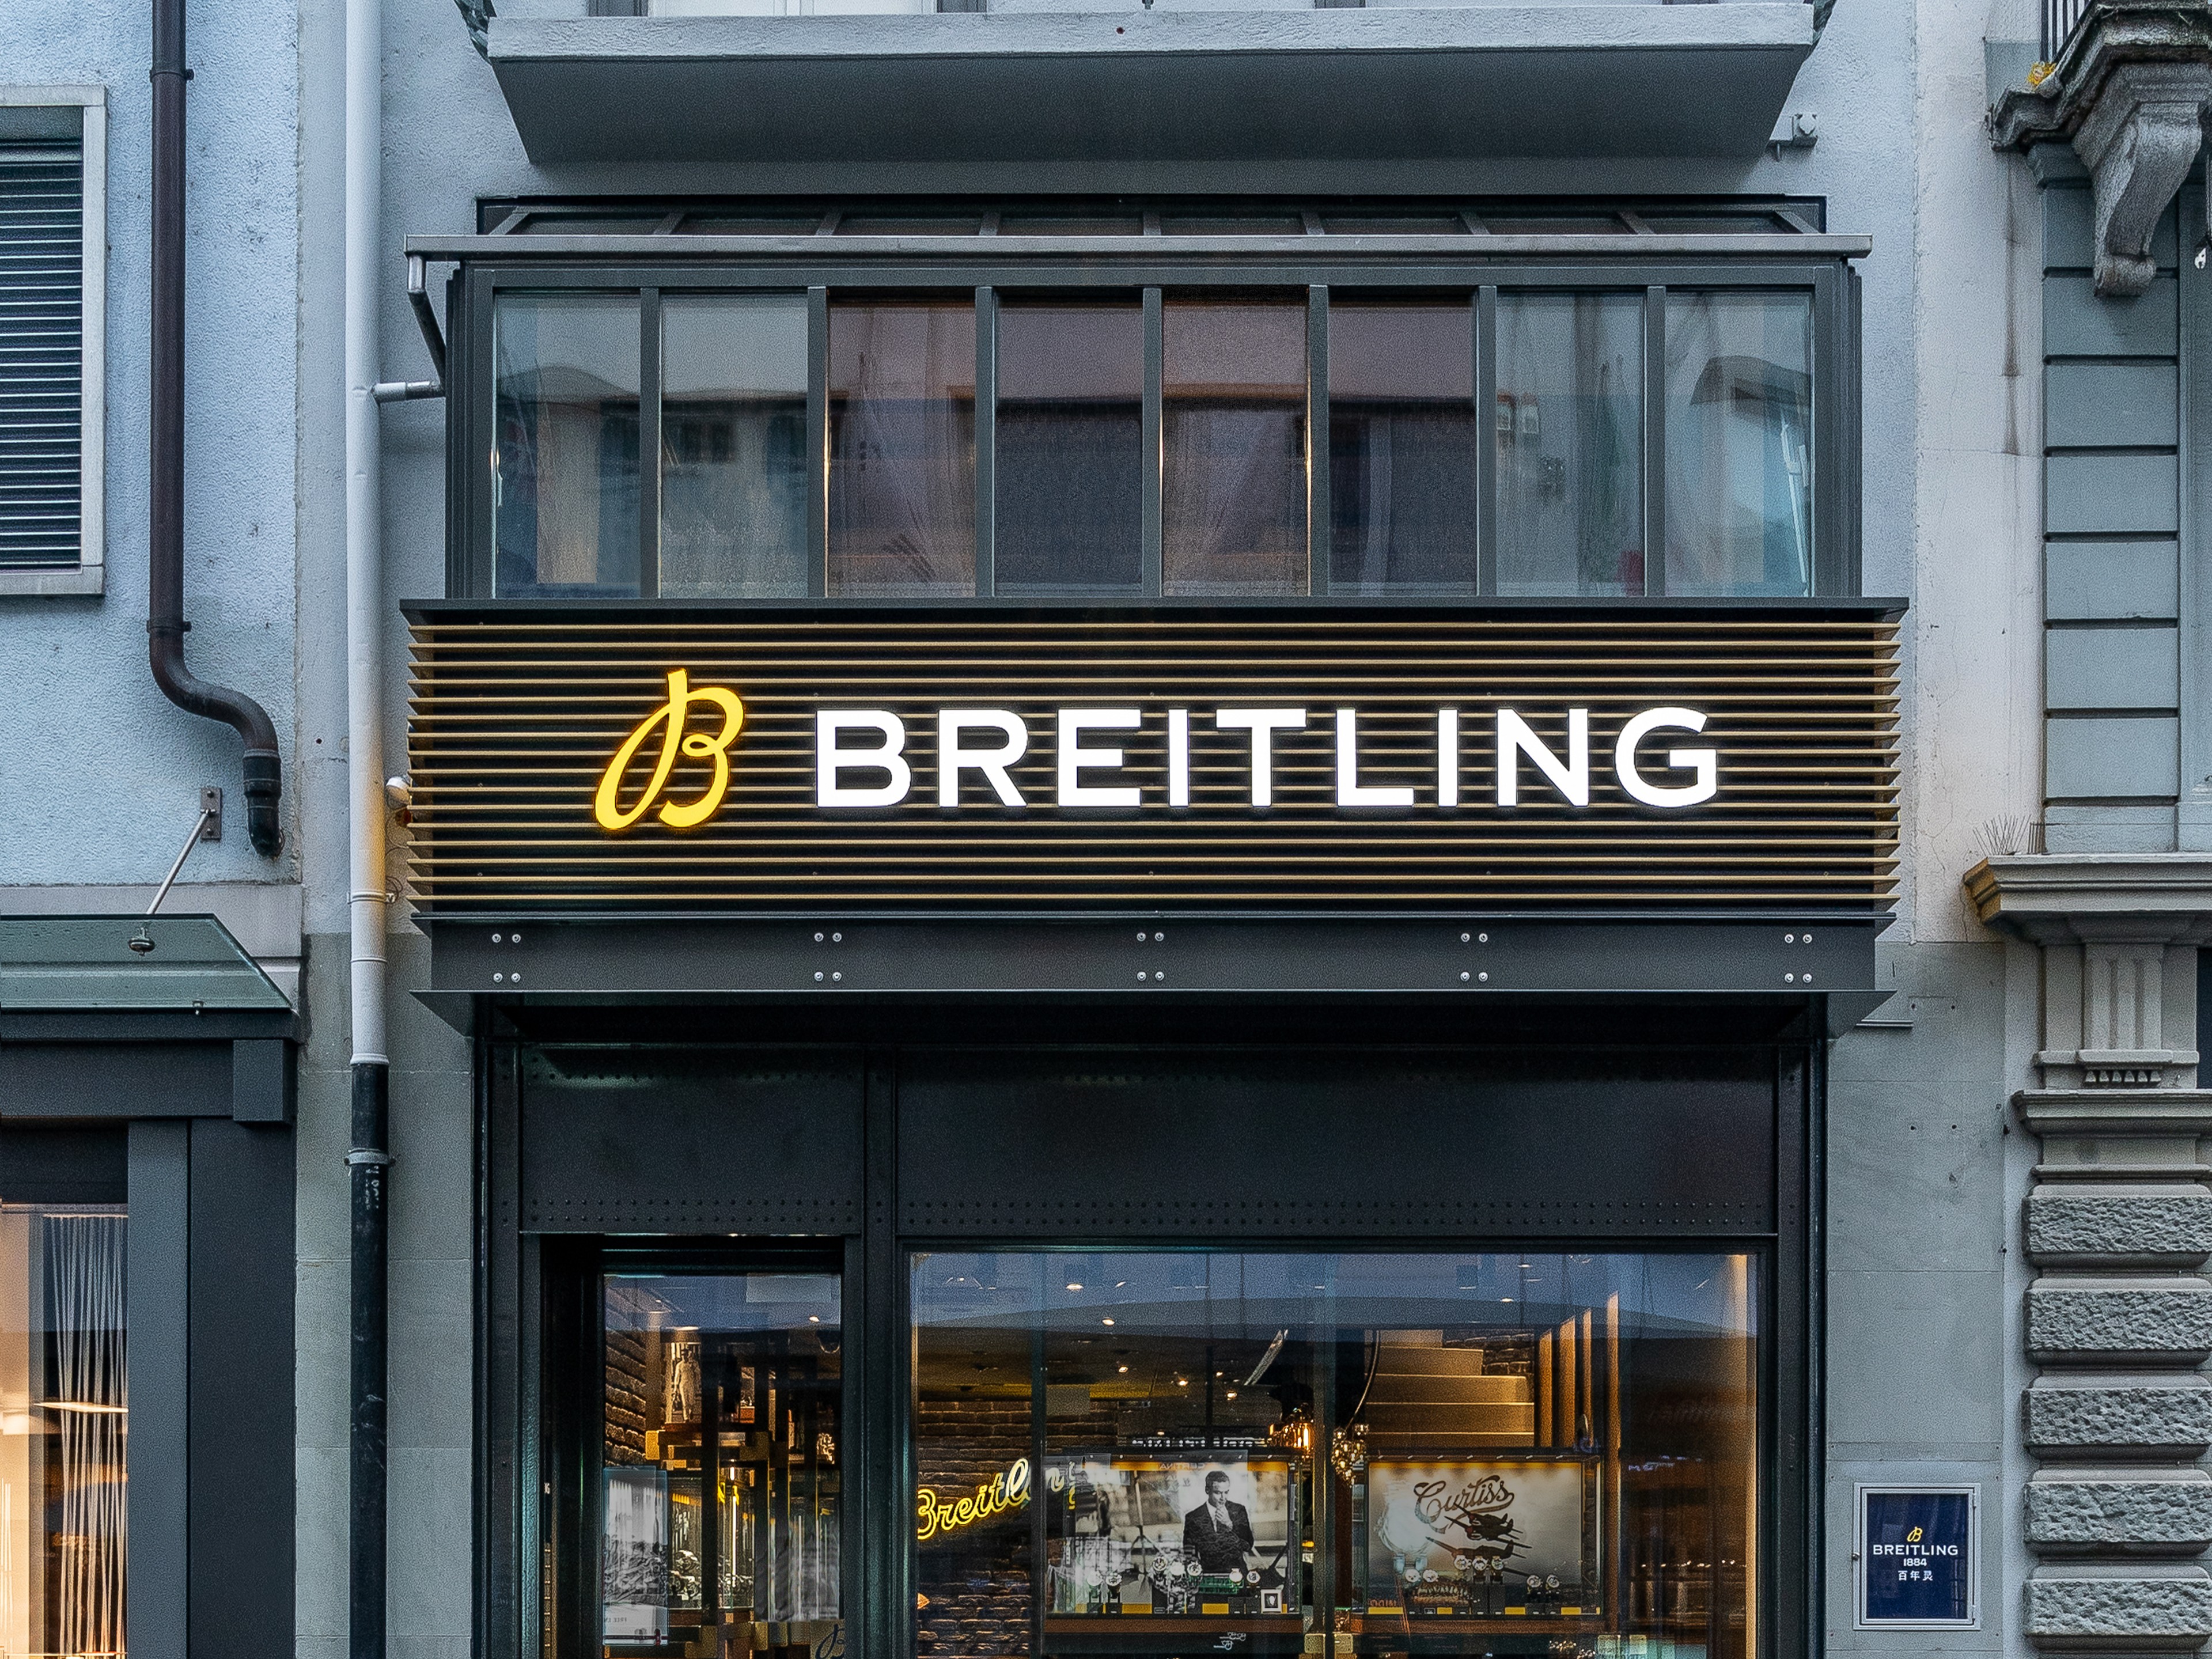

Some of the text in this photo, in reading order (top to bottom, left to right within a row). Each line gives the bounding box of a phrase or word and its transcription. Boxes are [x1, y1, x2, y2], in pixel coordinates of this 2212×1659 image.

[595, 668, 1718, 829] B BREITLING
[1414, 1475, 1515, 1535] Curtiss
[1873, 1544, 1959, 1555] BREITLING
[1903, 1558, 1927, 1566] 1884
[1898, 1570, 1933, 1581] 百年灵
